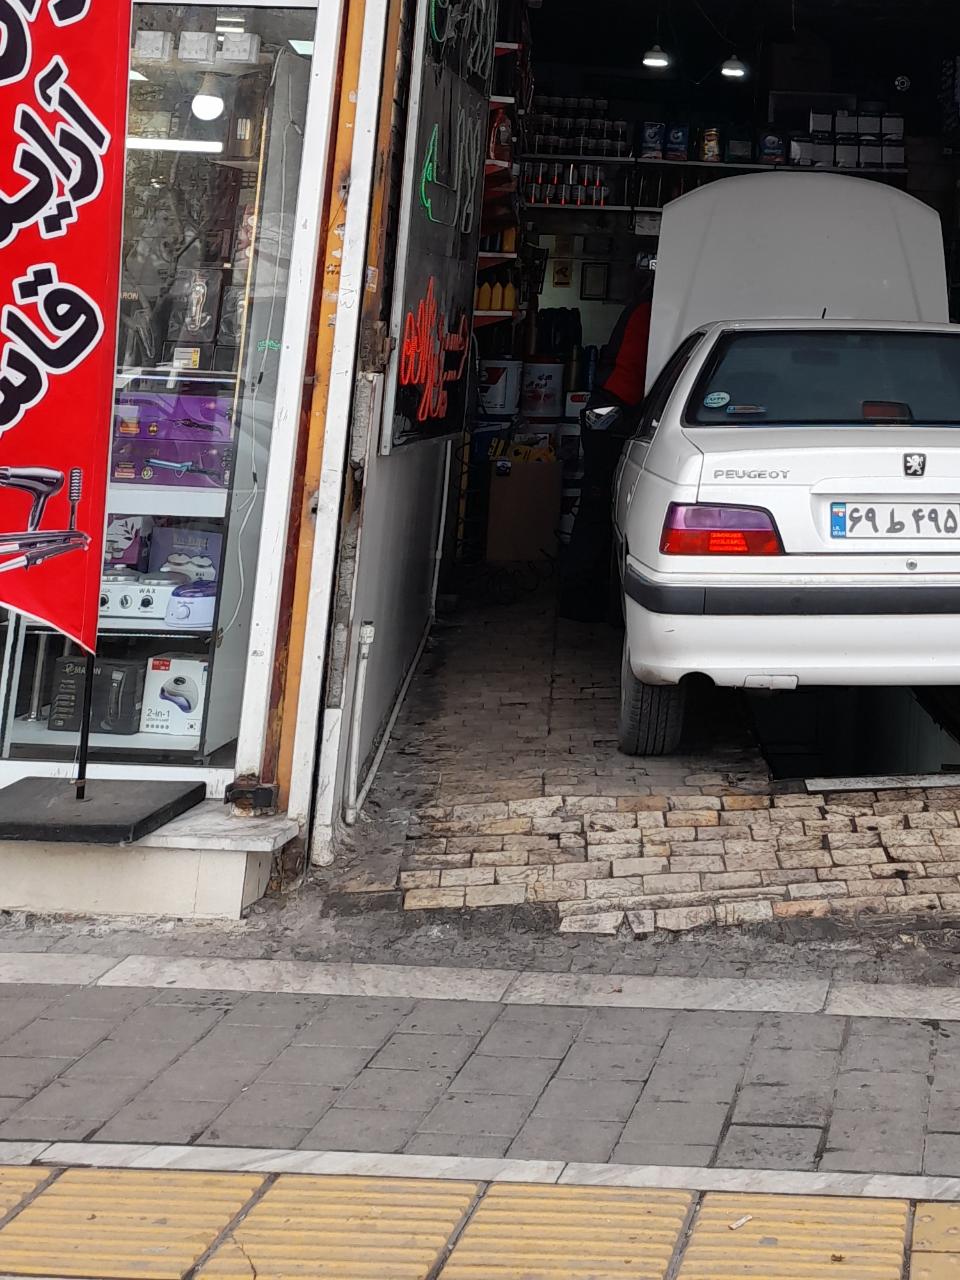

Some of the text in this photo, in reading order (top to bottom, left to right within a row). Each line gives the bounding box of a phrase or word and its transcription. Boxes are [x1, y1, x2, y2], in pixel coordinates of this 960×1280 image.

[713, 469, 790, 480] PEUGEOT
[849, 507, 879, 534] ۶۹
[885, 508, 906, 534] ط
[912, 508, 959, 535] ۴۹۵
[138, 587, 157, 595] WAX
[146, 708, 171, 718] 2-in-1
